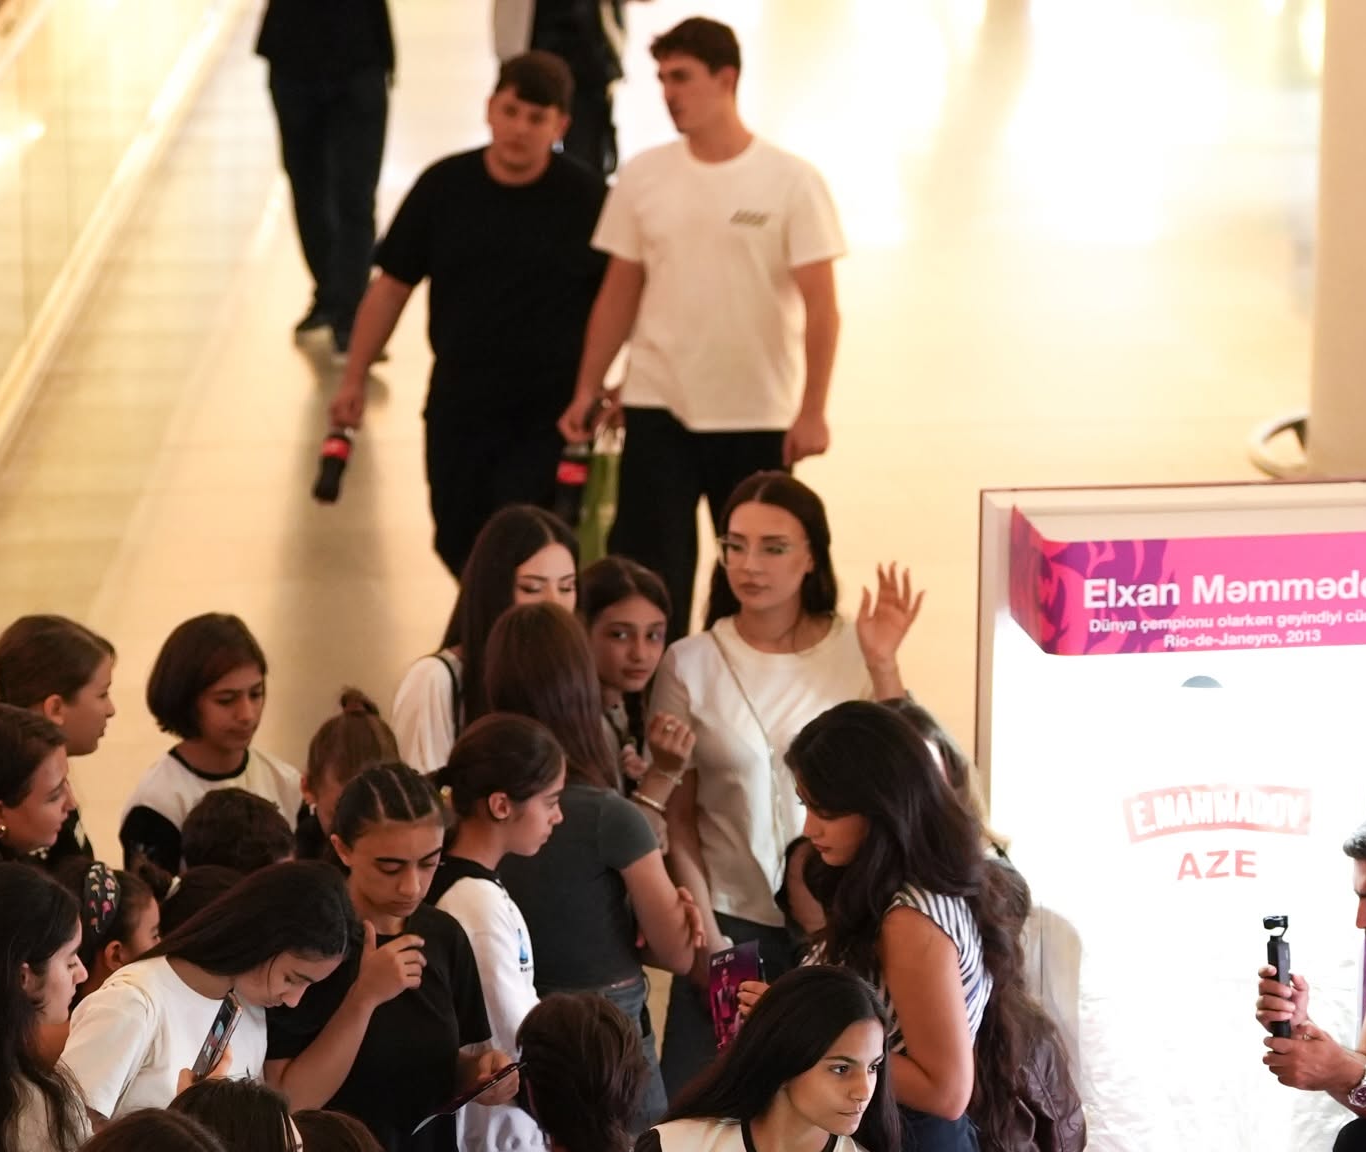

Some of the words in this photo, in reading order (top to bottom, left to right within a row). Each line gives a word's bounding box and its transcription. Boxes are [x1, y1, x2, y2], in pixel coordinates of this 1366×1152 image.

[1083, 577, 1181, 609] Elxan
[1089, 618, 1137, 634] Dünya
[1140, 615, 1214, 634] çempionu
[1286, 628, 1322, 643] 2013
[1177, 850, 1258, 881] AZE
